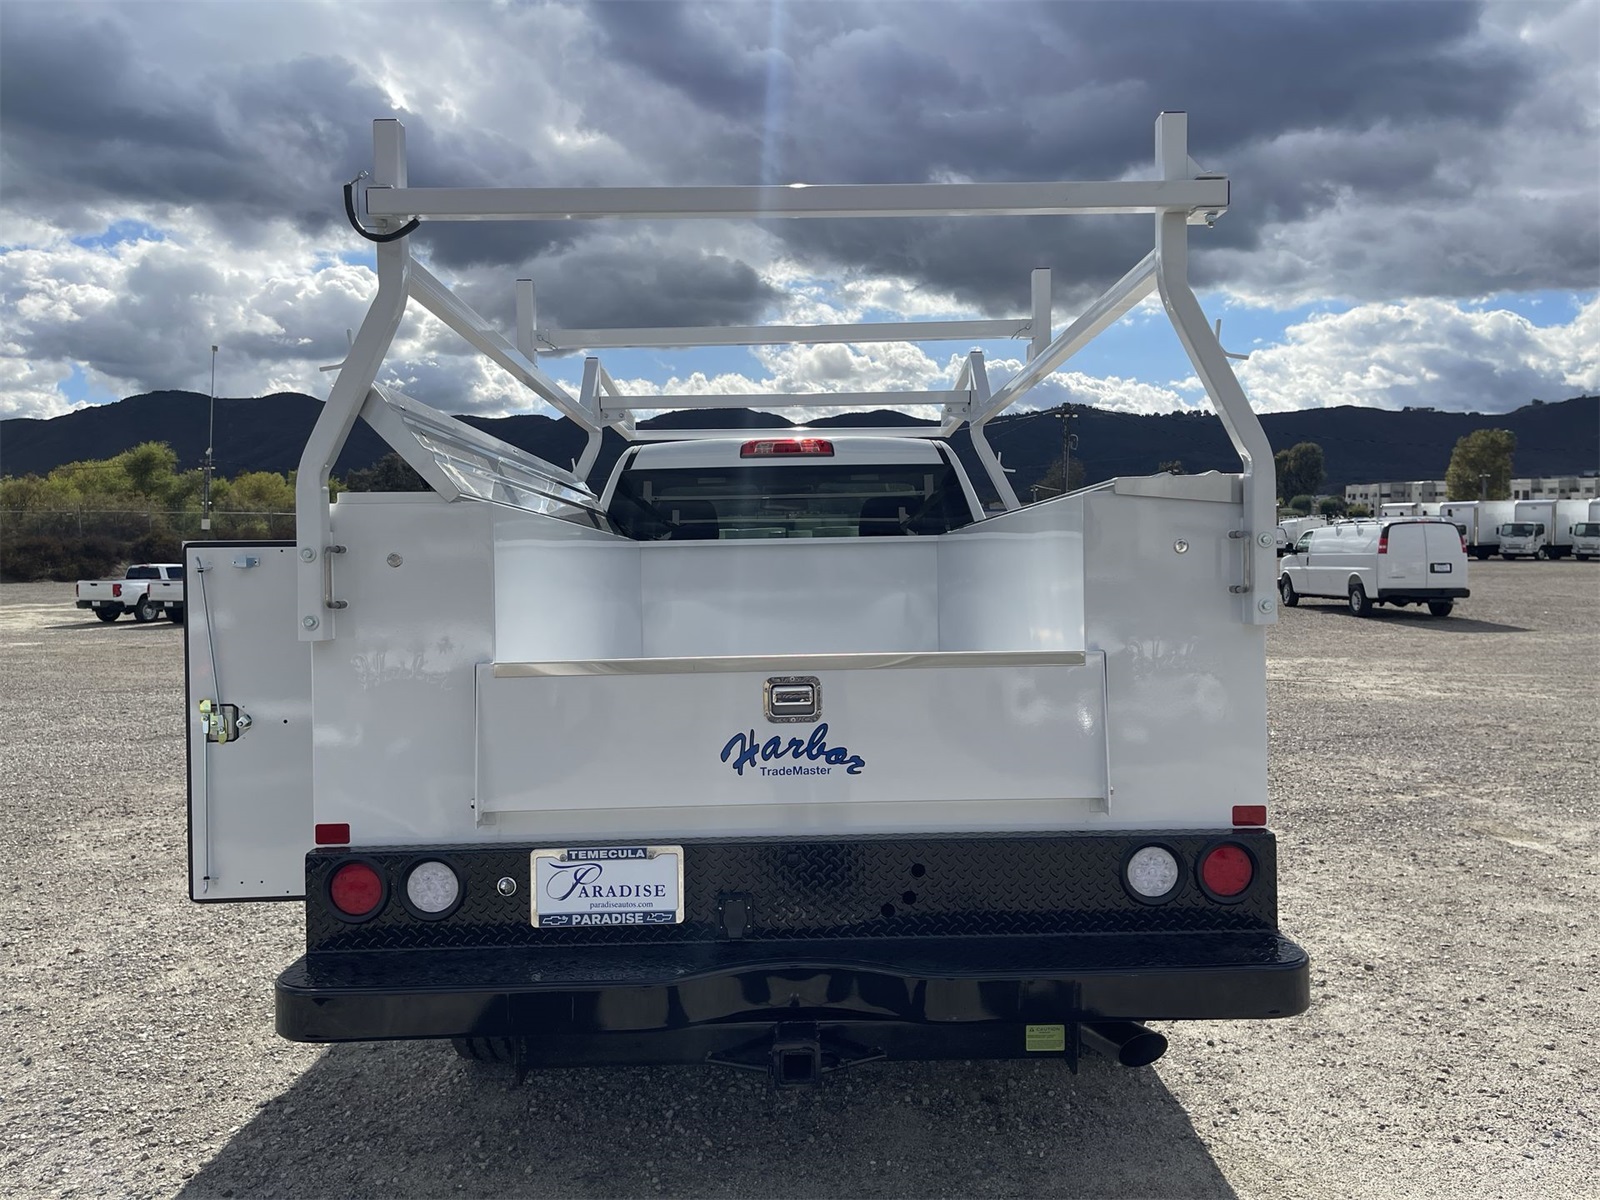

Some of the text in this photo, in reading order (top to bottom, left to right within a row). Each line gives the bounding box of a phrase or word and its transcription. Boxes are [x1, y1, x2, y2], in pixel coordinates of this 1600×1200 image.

[720, 722, 866, 776] Harbor
[760, 766, 832, 776] TradeMaster
[569, 849, 646, 860] TEMECULA
[589, 900, 654, 910] paradiseautos.com
[572, 913, 644, 926] PARADISE
